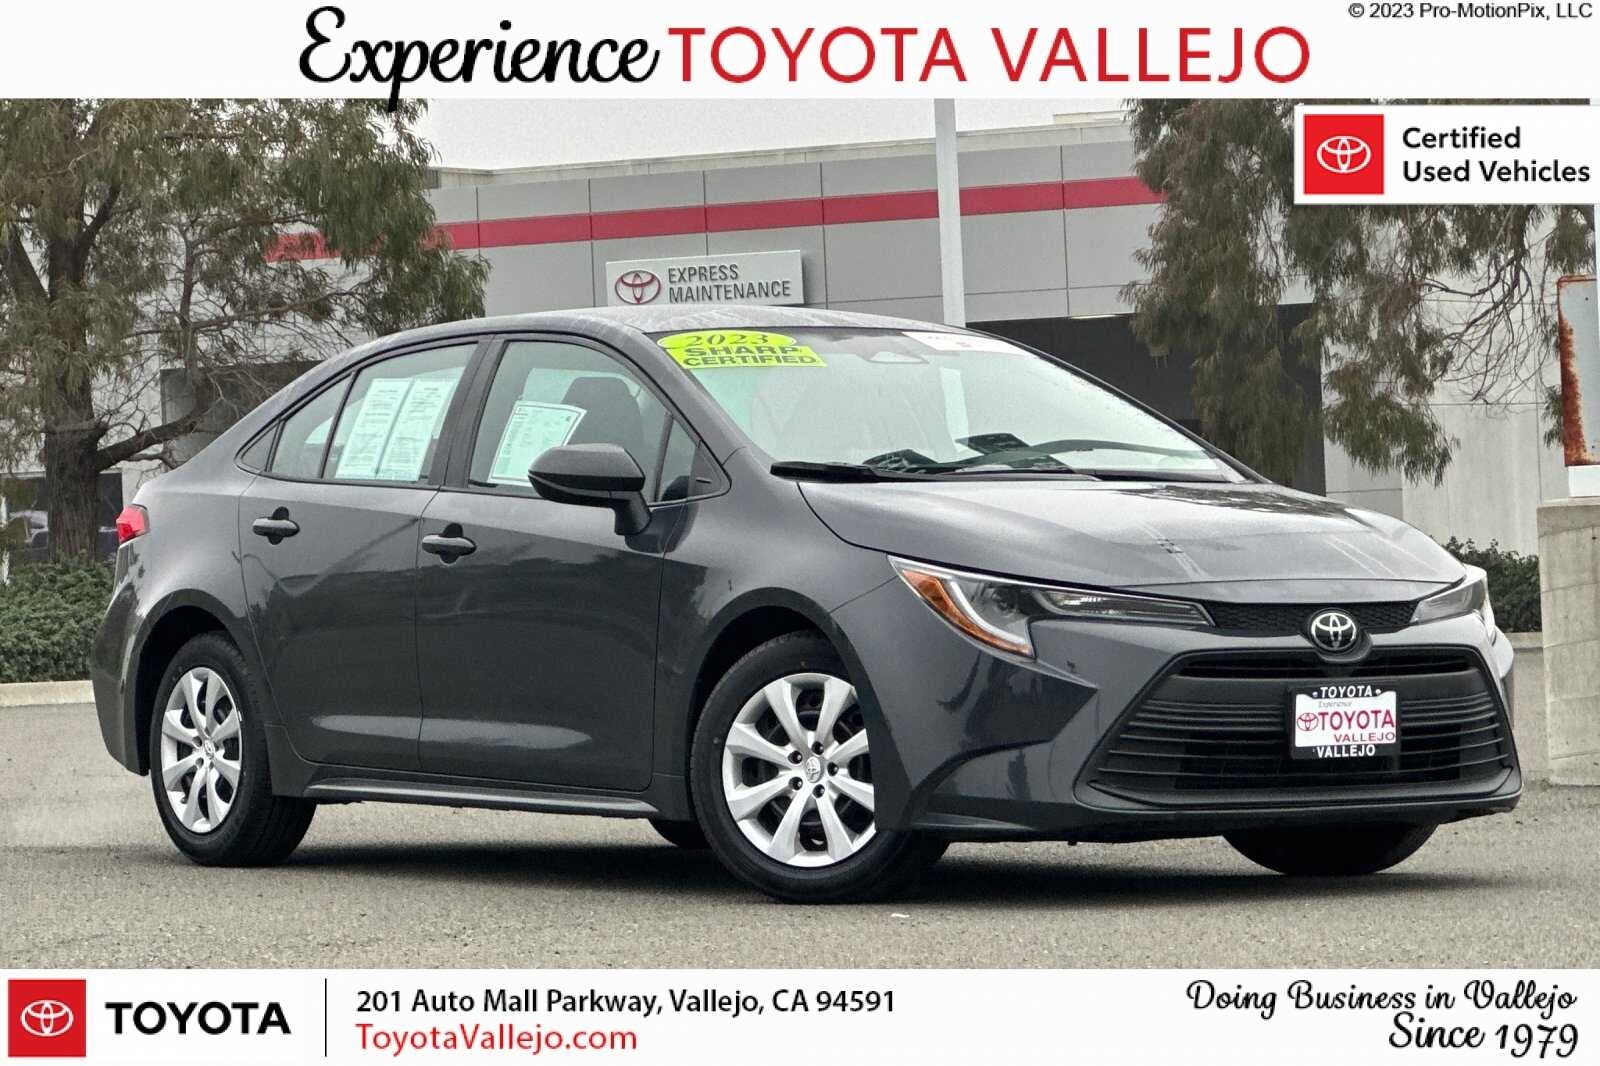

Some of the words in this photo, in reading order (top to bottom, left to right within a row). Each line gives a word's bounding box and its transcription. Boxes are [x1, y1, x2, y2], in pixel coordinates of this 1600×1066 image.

[668, 264, 739, 283] EXPRESS
[669, 280, 792, 303] MAINTENANCE
[686, 334, 769, 347] 2023
[685, 345, 799, 356] SHARP
[683, 355, 817, 367] CERTIFIED
[1320, 685, 1373, 699] TOYOTA
[1318, 709, 1395, 731] TOYOTA
[1333, 731, 1396, 743] VALLEJO
[1316, 744, 1376, 758] VALLEJO
